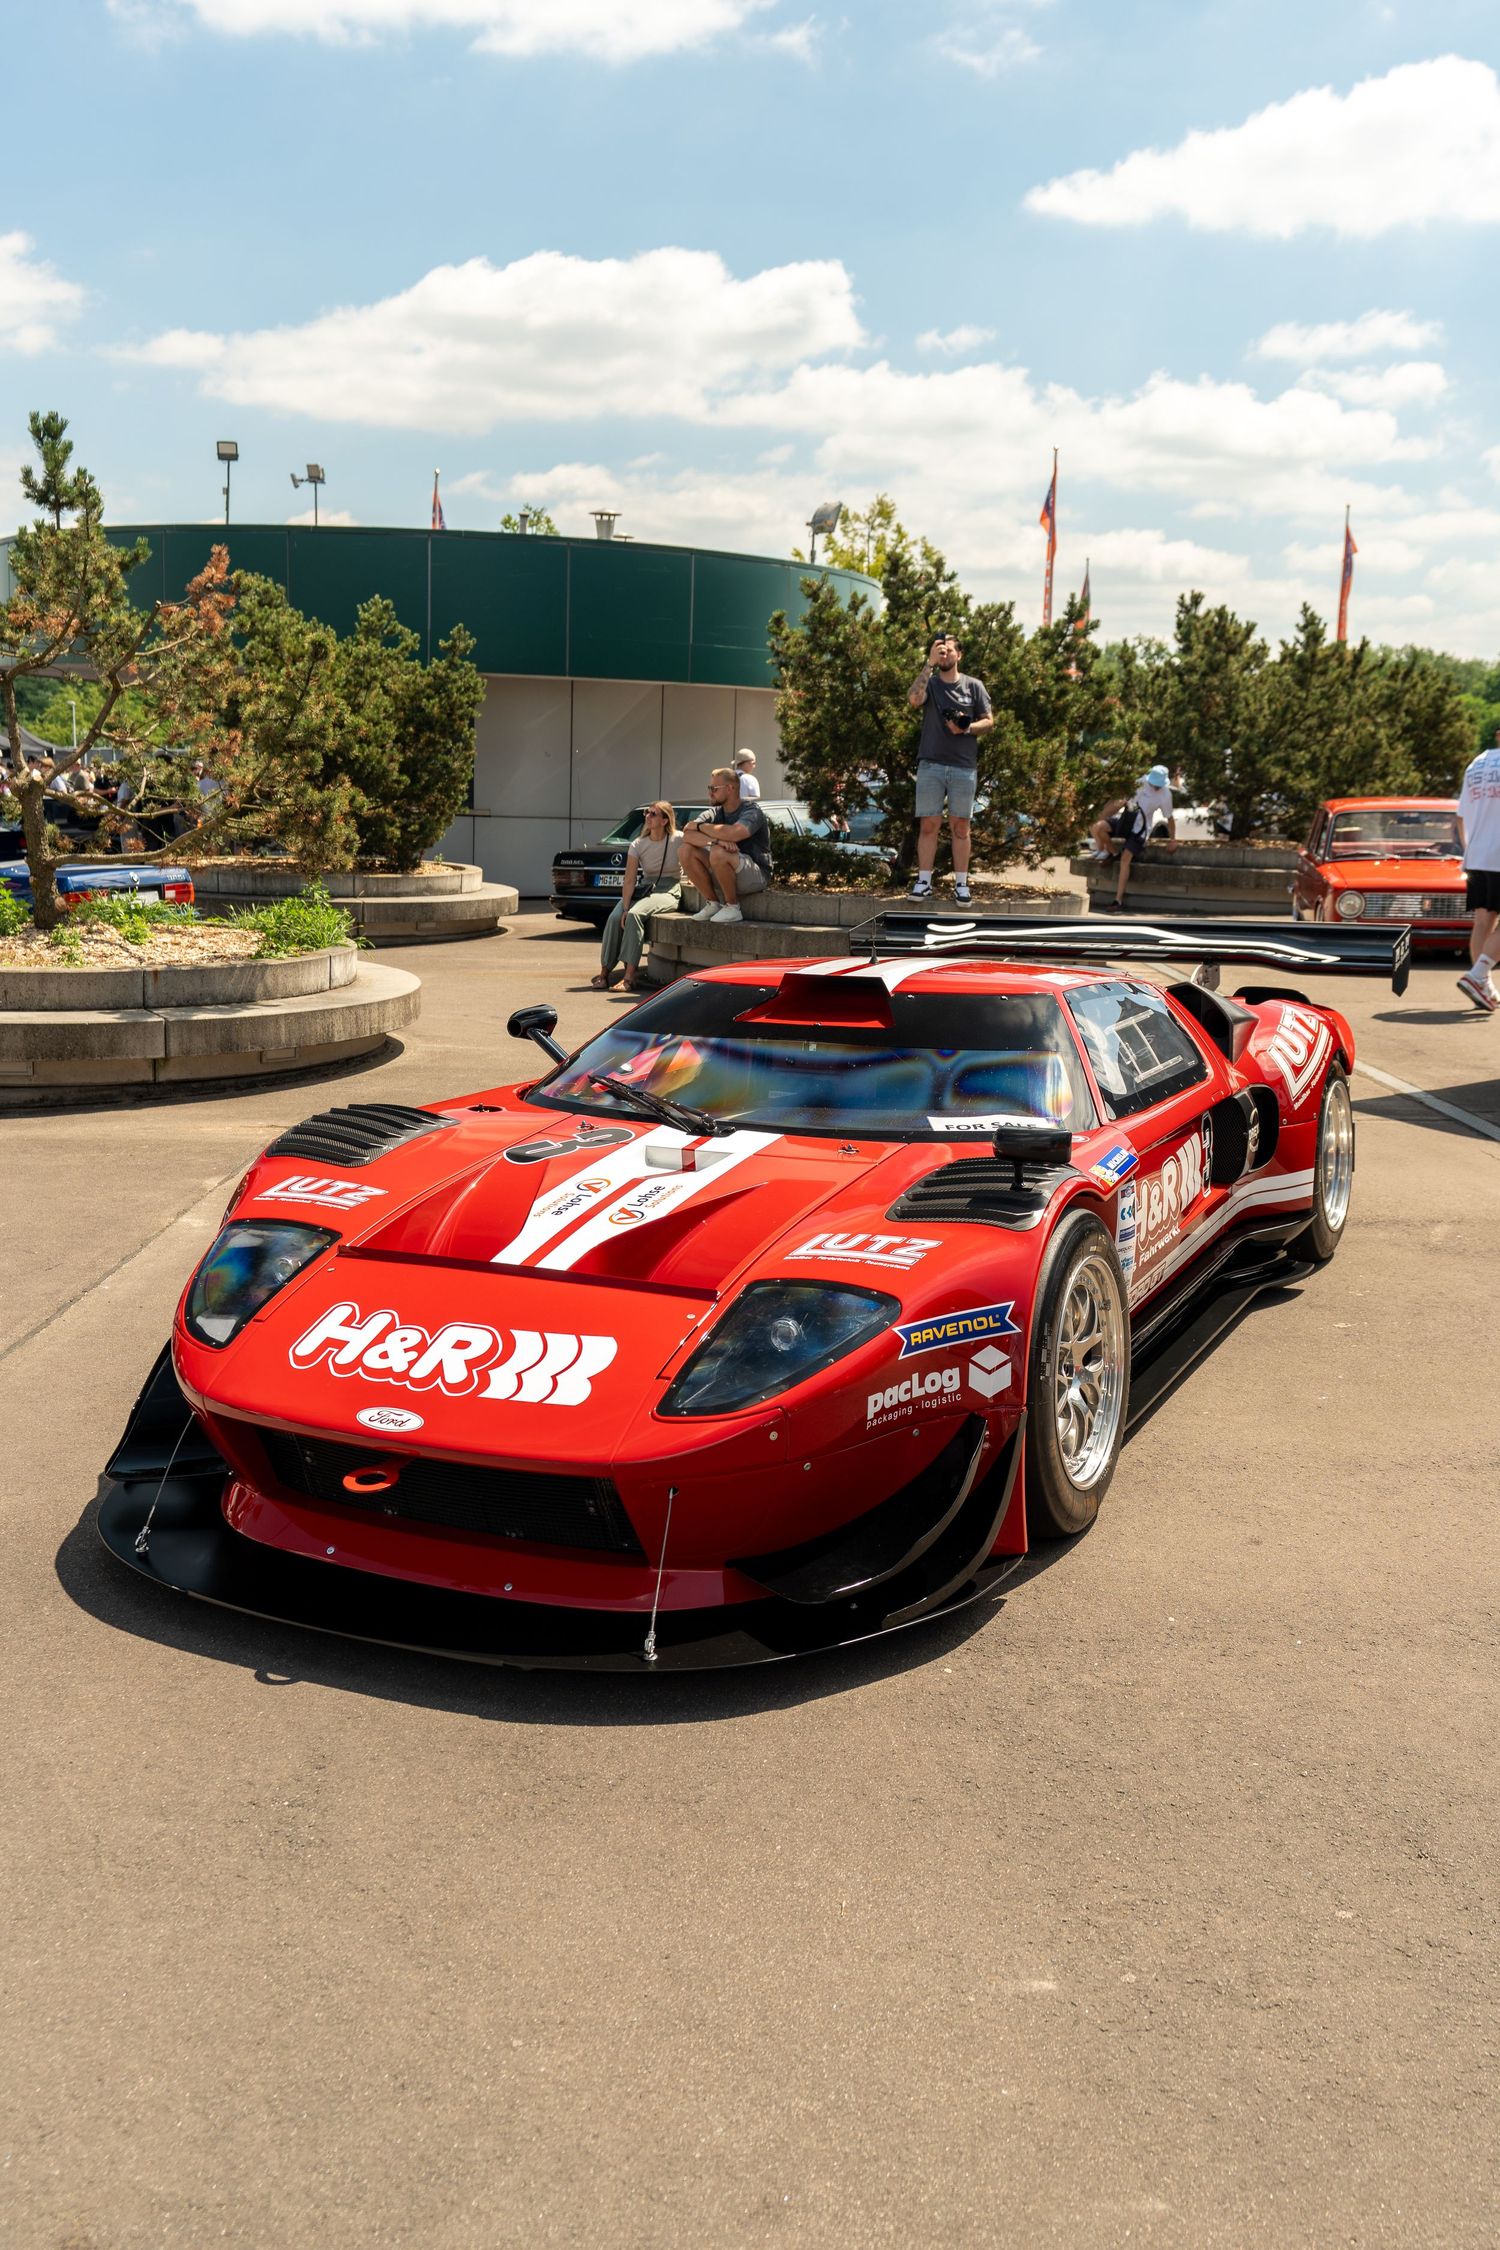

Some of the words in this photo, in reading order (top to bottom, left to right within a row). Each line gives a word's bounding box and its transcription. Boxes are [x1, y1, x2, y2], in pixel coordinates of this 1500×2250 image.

[1267, 1004, 1330, 1101] LUTZ
[503, 1127, 636, 1165] 3
[257, 1175, 389, 1208] LUTZ
[551, 1193, 593, 1216] Lohse
[627, 1185, 666, 1208] Lohse
[645, 1184, 684, 1209] Solutions
[1135, 1156, 1180, 1249] H&R
[788, 1233, 944, 1266] LUTZ
[290, 1301, 501, 1394] H&R
[909, 1315, 1001, 1347] RAVENOL
[866, 1366, 961, 1421] pacLog
[369, 1409, 409, 1429] Ford
[865, 1404, 913, 1431] packaging
[921, 1392, 962, 1410] logistic
